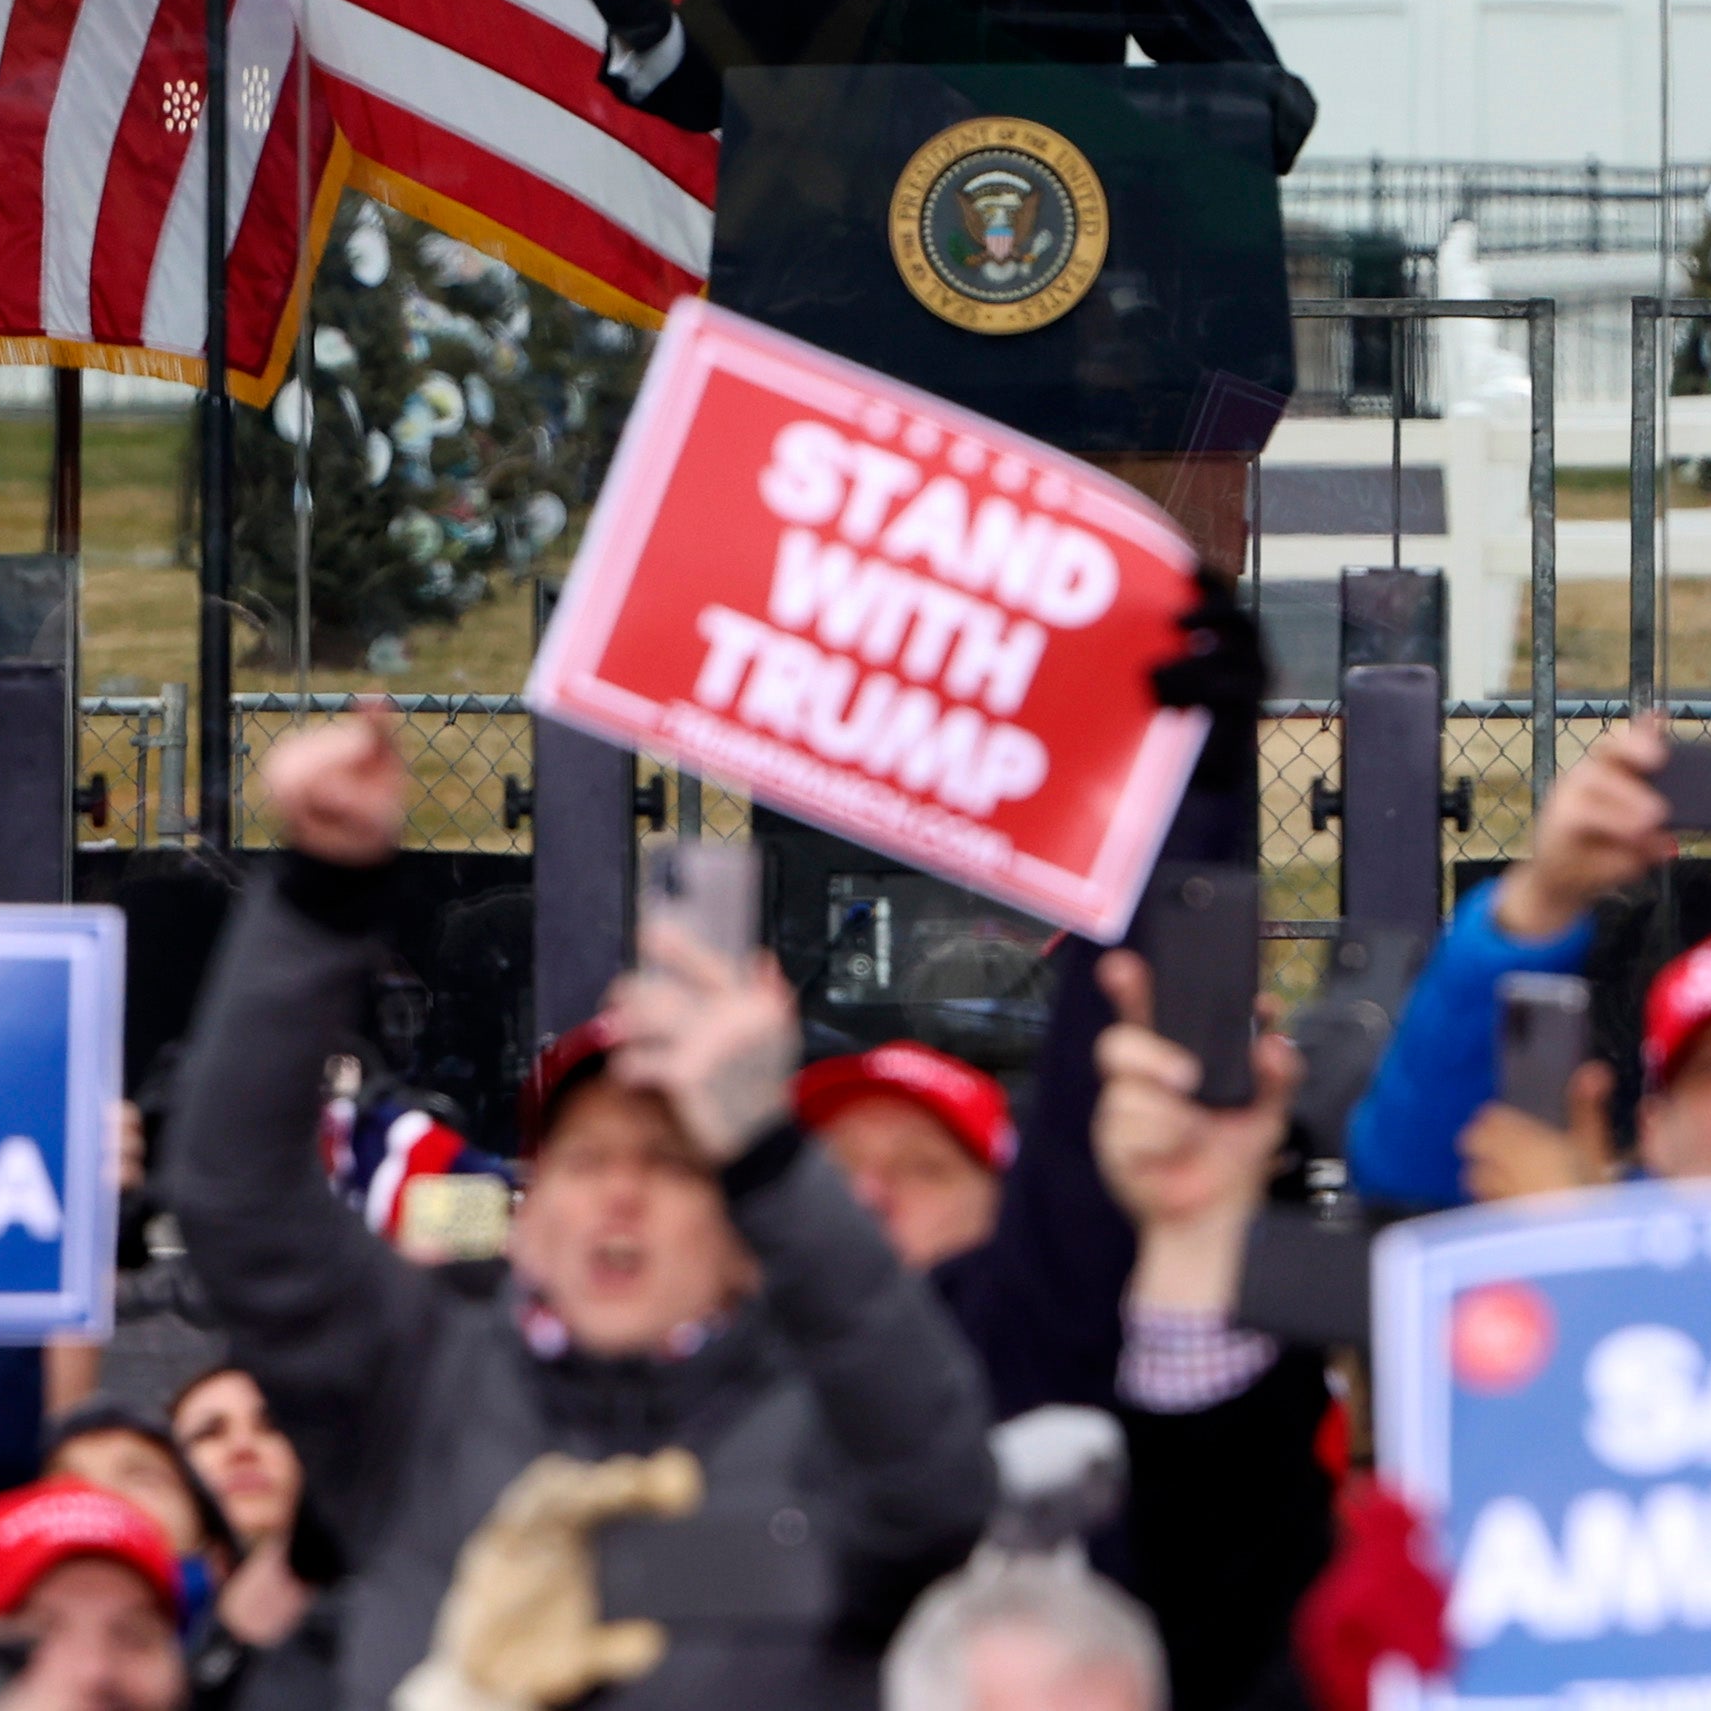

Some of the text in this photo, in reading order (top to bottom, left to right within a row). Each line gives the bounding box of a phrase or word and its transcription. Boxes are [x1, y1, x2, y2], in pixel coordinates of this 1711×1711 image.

[896, 123, 989, 221] PRESIDENT
[1054, 145, 1103, 238] UNITED
[1019, 257, 1096, 327] STATES
[759, 420, 1119, 630] STAND
[769, 527, 1047, 716] WITH
[697, 604, 1050, 819] TRUMP
